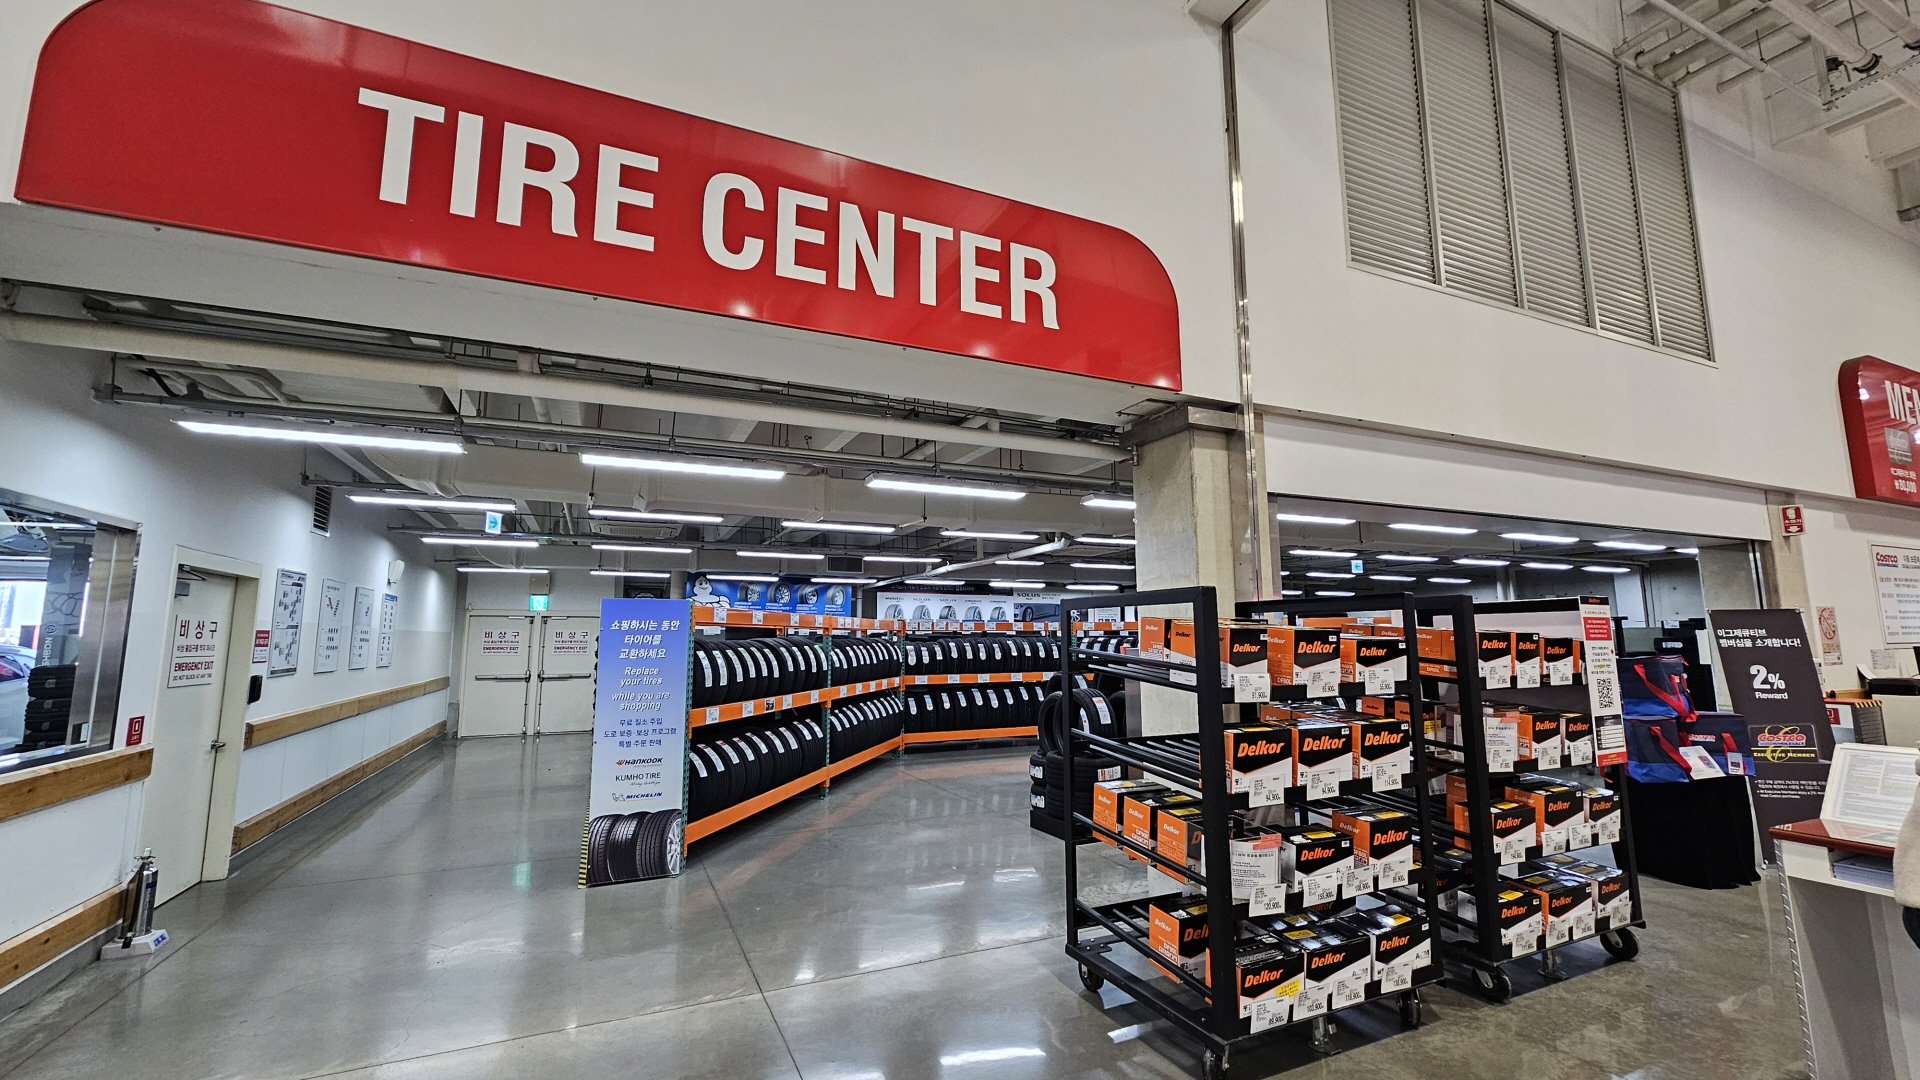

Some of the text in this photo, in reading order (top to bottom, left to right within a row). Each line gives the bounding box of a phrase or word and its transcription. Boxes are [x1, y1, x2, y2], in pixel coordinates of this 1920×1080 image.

[358, 87, 1060, 330] TIRE CENTER
[610, 620, 680, 631] 쇼핑하시는 동안
[1717, 628, 1767, 637] 이그제큐티브
[624, 634, 662, 645] 타이어를
[1482, 640, 1508, 649] Delkor
[1755, 638, 1801, 647] 소개합니다!
[1233, 644, 1261, 652] Delkor
[1297, 641, 1336, 653] Delkor
[1360, 647, 1387, 656] Delkor
[1518, 642, 1537, 650] Delkor
[619, 648, 666, 659] 교환하세요
[174, 660, 214, 672] EMERGENCY EXIT
[624, 666, 660, 677] Replace
[620, 677, 663, 688] your tires
[1750, 664, 1786, 689] 2%
[612, 691, 670, 702] while you are
[620, 701, 662, 712] shopping
[1535, 720, 1558, 731] Delkor
[1569, 722, 1590, 732] Delkor
[1303, 736, 1346, 751] Delkor
[1364, 731, 1404, 746] Delkor
[1237, 740, 1284, 757] Delkor
[615, 773, 644, 782] KUMHO
[1548, 800, 1570, 812] Delkor
[1592, 801, 1612, 811] Delkor
[1129, 808, 1144, 819] Delkor
[1163, 823, 1180, 835] Delkor
[1339, 822, 1360, 834] Delkor
[1496, 817, 1522, 829] Delkor
[1373, 830, 1409, 846] Delkor
[1301, 848, 1335, 861] Delkor
[1602, 882, 1621, 894] Delkor
[1552, 895, 1573, 908] Delkor
[1501, 906, 1527, 918] Delkor
[1155, 918, 1172, 932] Delkor
[1380, 936, 1410, 951] Delkor
[1311, 952, 1346, 969] Delkor
[1245, 969, 1284, 988] Delkor
